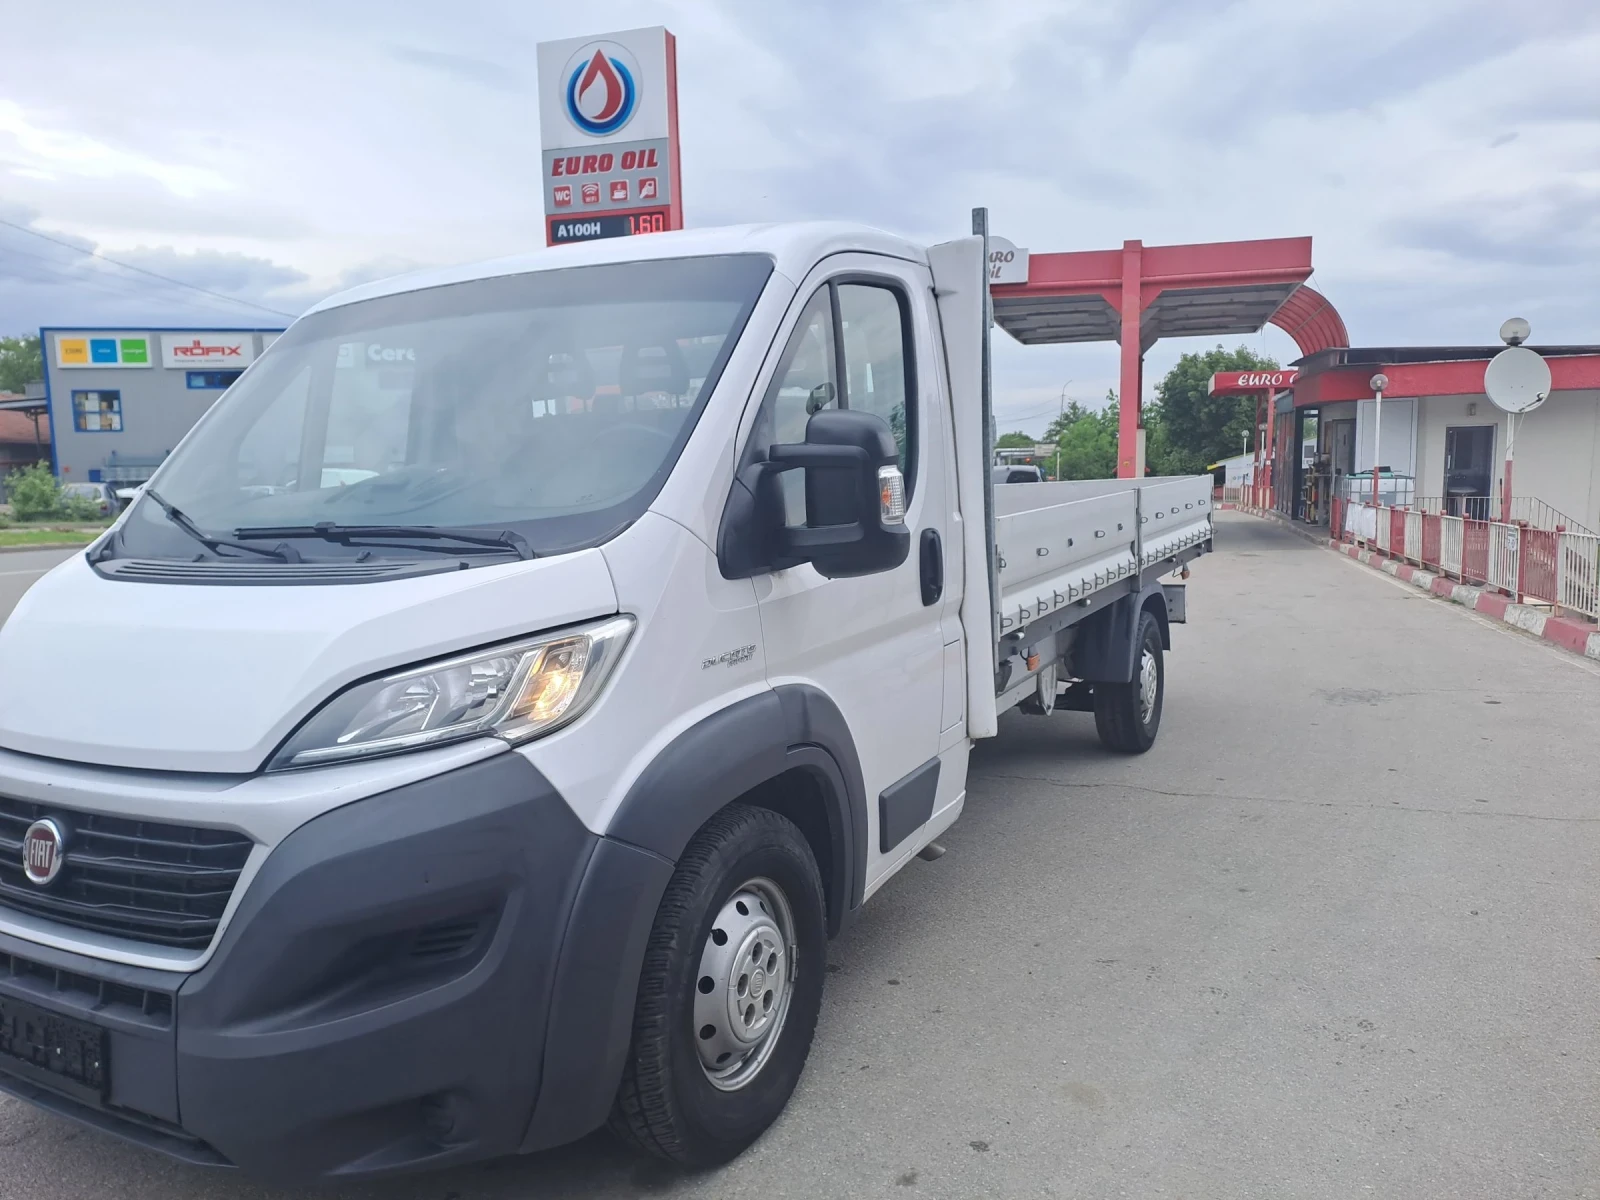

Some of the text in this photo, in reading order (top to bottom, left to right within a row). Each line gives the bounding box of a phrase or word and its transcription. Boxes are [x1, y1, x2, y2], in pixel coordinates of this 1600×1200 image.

[551, 148, 659, 177] EURO OIL
[555, 190, 571, 202] WC
[557, 214, 663, 237] A100H 1.60
[989, 250, 1015, 263] URO
[1238, 373, 1283, 386] EURO
[30, 838, 54, 869] FIAT
